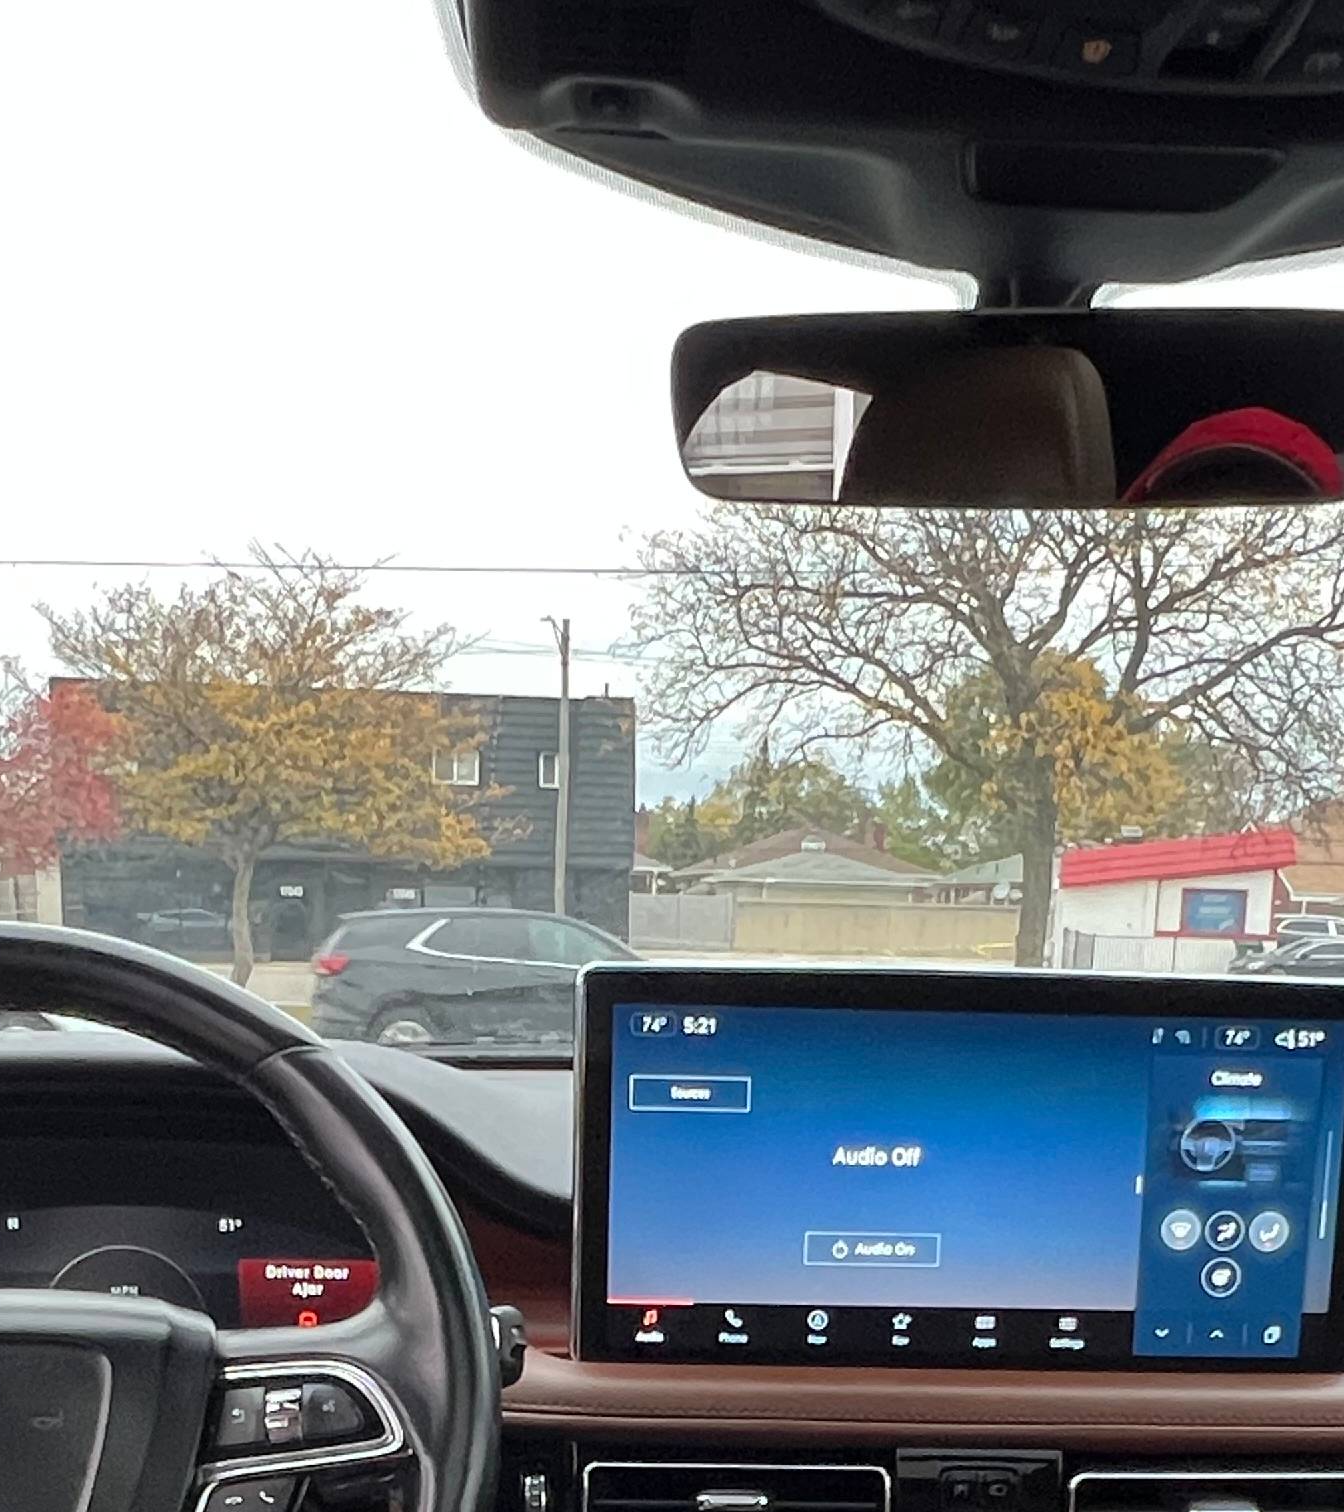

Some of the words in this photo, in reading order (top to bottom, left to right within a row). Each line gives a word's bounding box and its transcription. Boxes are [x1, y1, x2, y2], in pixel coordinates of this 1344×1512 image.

[682, 1016, 718, 1035] 5:21
[832, 1146, 888, 1166] Audio
[891, 1146, 922, 1167] Off
[854, 1242, 893, 1256] Audio
[894, 1241, 916, 1256] On
[264, 1264, 310, 1279] Driver
[312, 1264, 350, 1280] Door
[292, 1281, 324, 1298] Ajar
